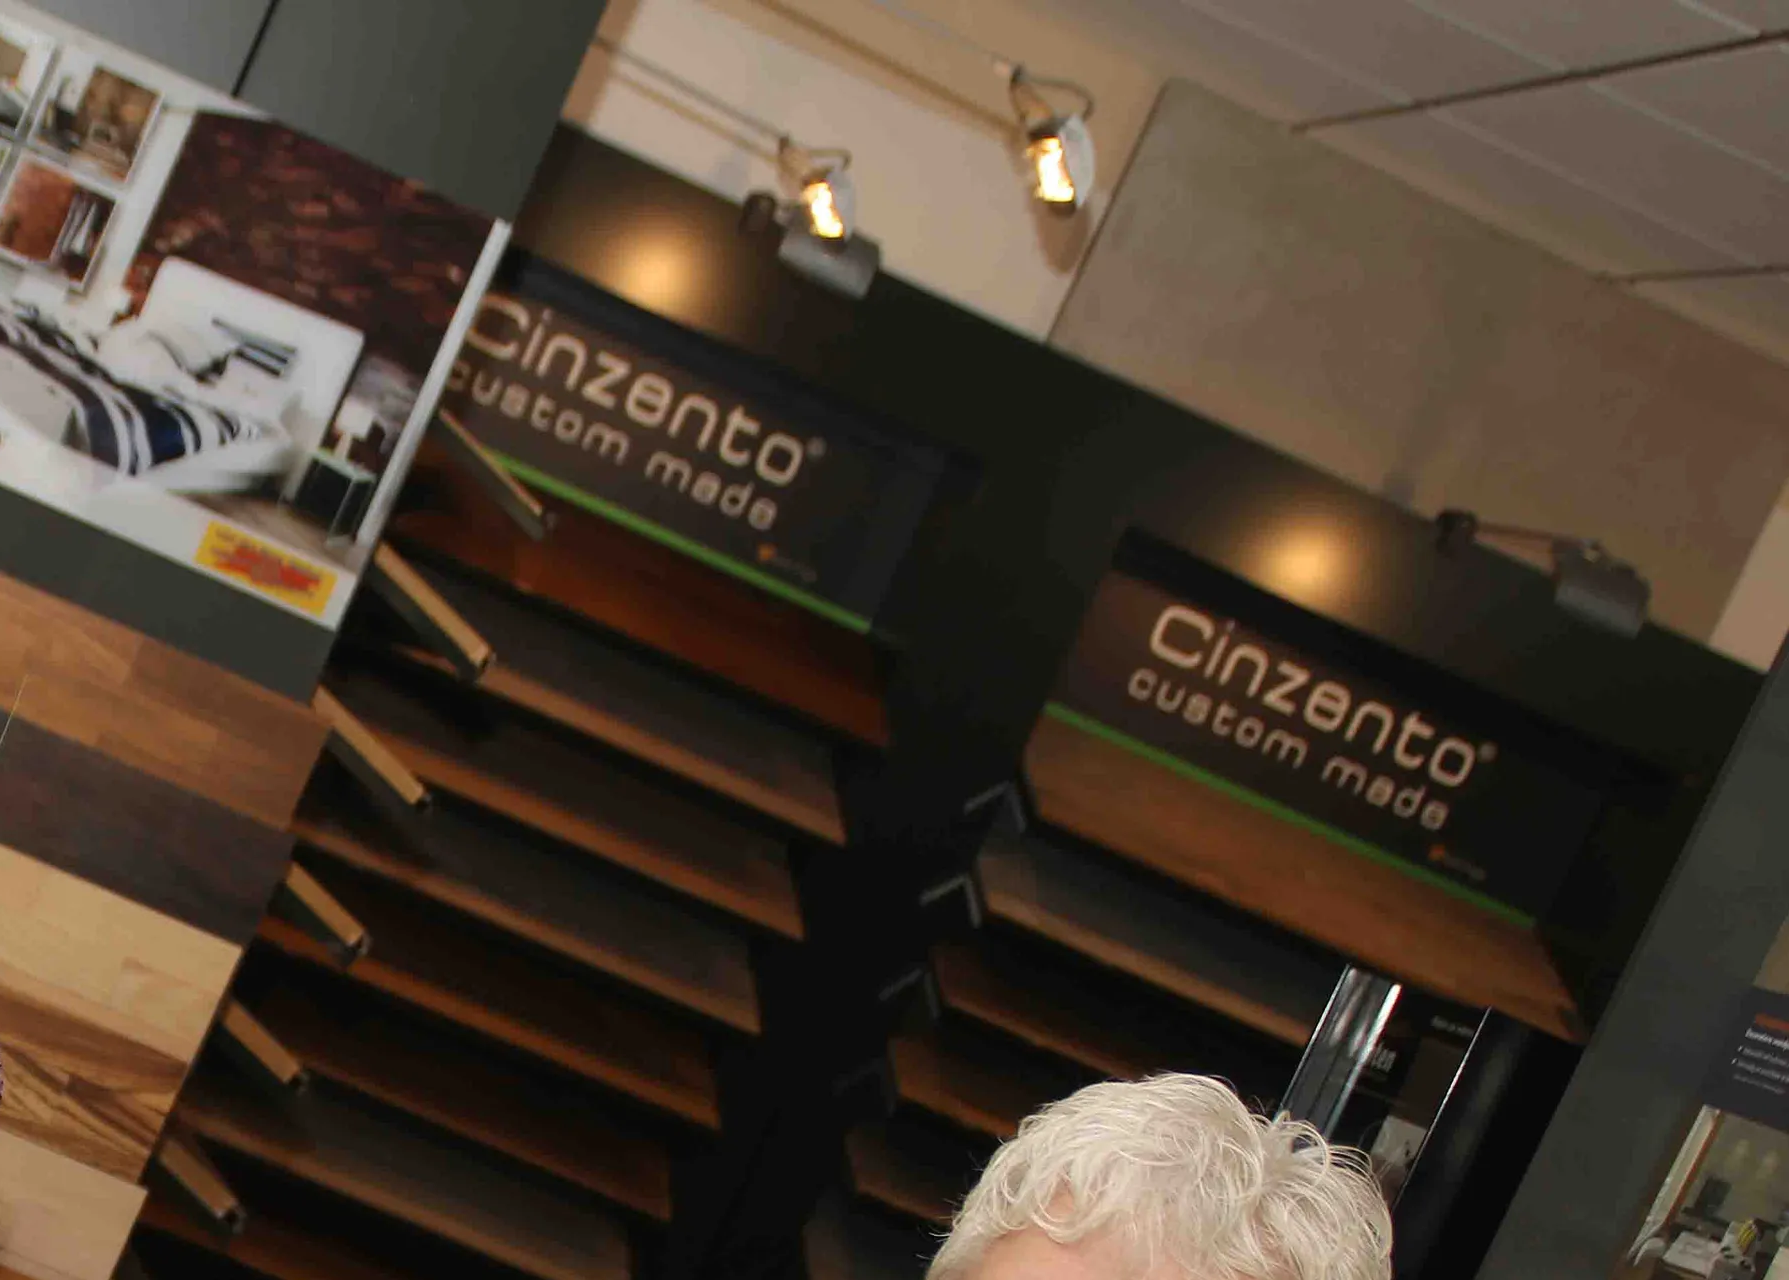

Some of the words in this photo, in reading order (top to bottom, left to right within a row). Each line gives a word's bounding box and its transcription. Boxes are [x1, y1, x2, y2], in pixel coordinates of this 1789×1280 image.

[446, 362, 631, 465] custom
[646, 448, 779, 532] made
[464, 291, 806, 487] Cinzento
[1128, 667, 1309, 770] custom
[1321, 754, 1451, 831] made
[1148, 603, 1478, 789] Cinzento
